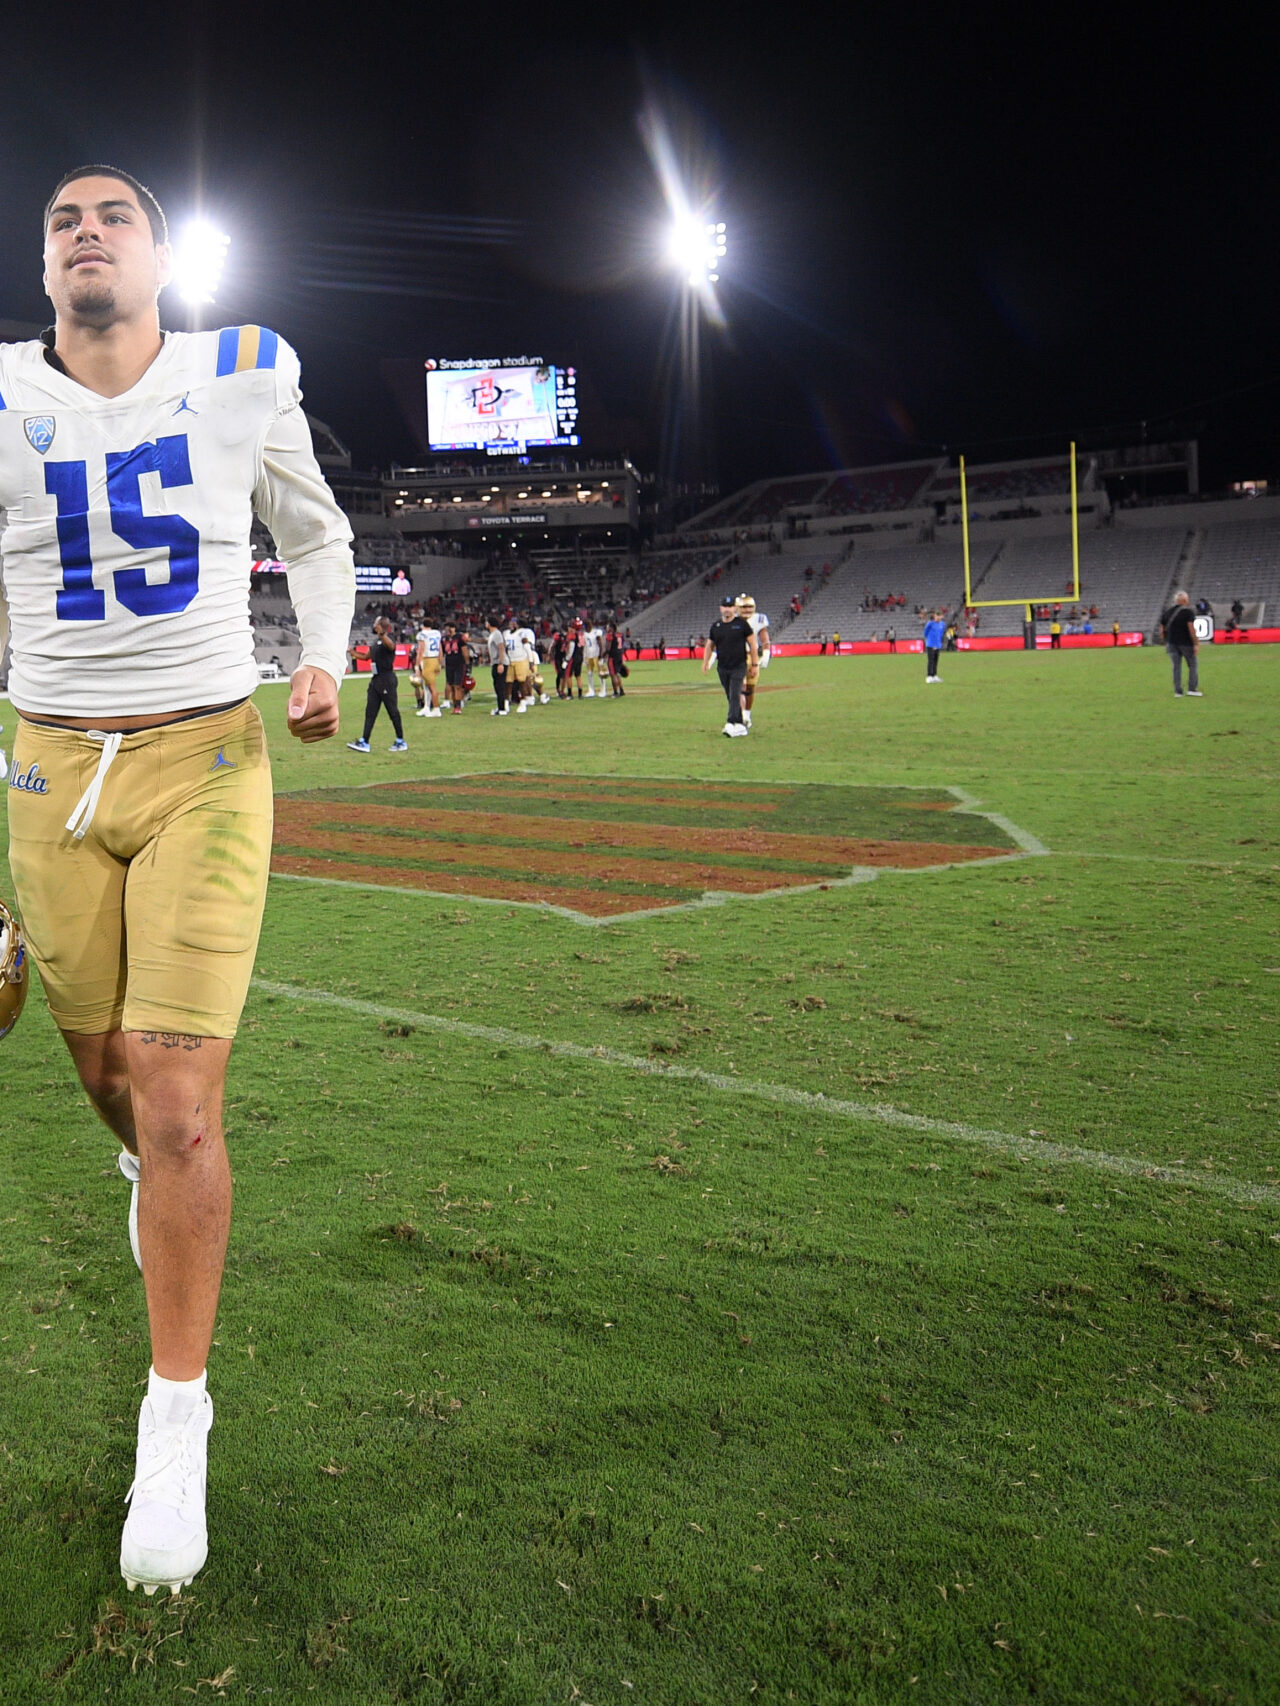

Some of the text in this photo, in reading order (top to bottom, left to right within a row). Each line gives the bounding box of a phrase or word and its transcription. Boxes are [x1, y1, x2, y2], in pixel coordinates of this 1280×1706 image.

[438, 355, 544, 371] Snapdragon stadium
[33, 430, 50, 447] 12
[43, 433, 200, 621] 15
[481, 514, 546, 525] TOYOTA TERRACE
